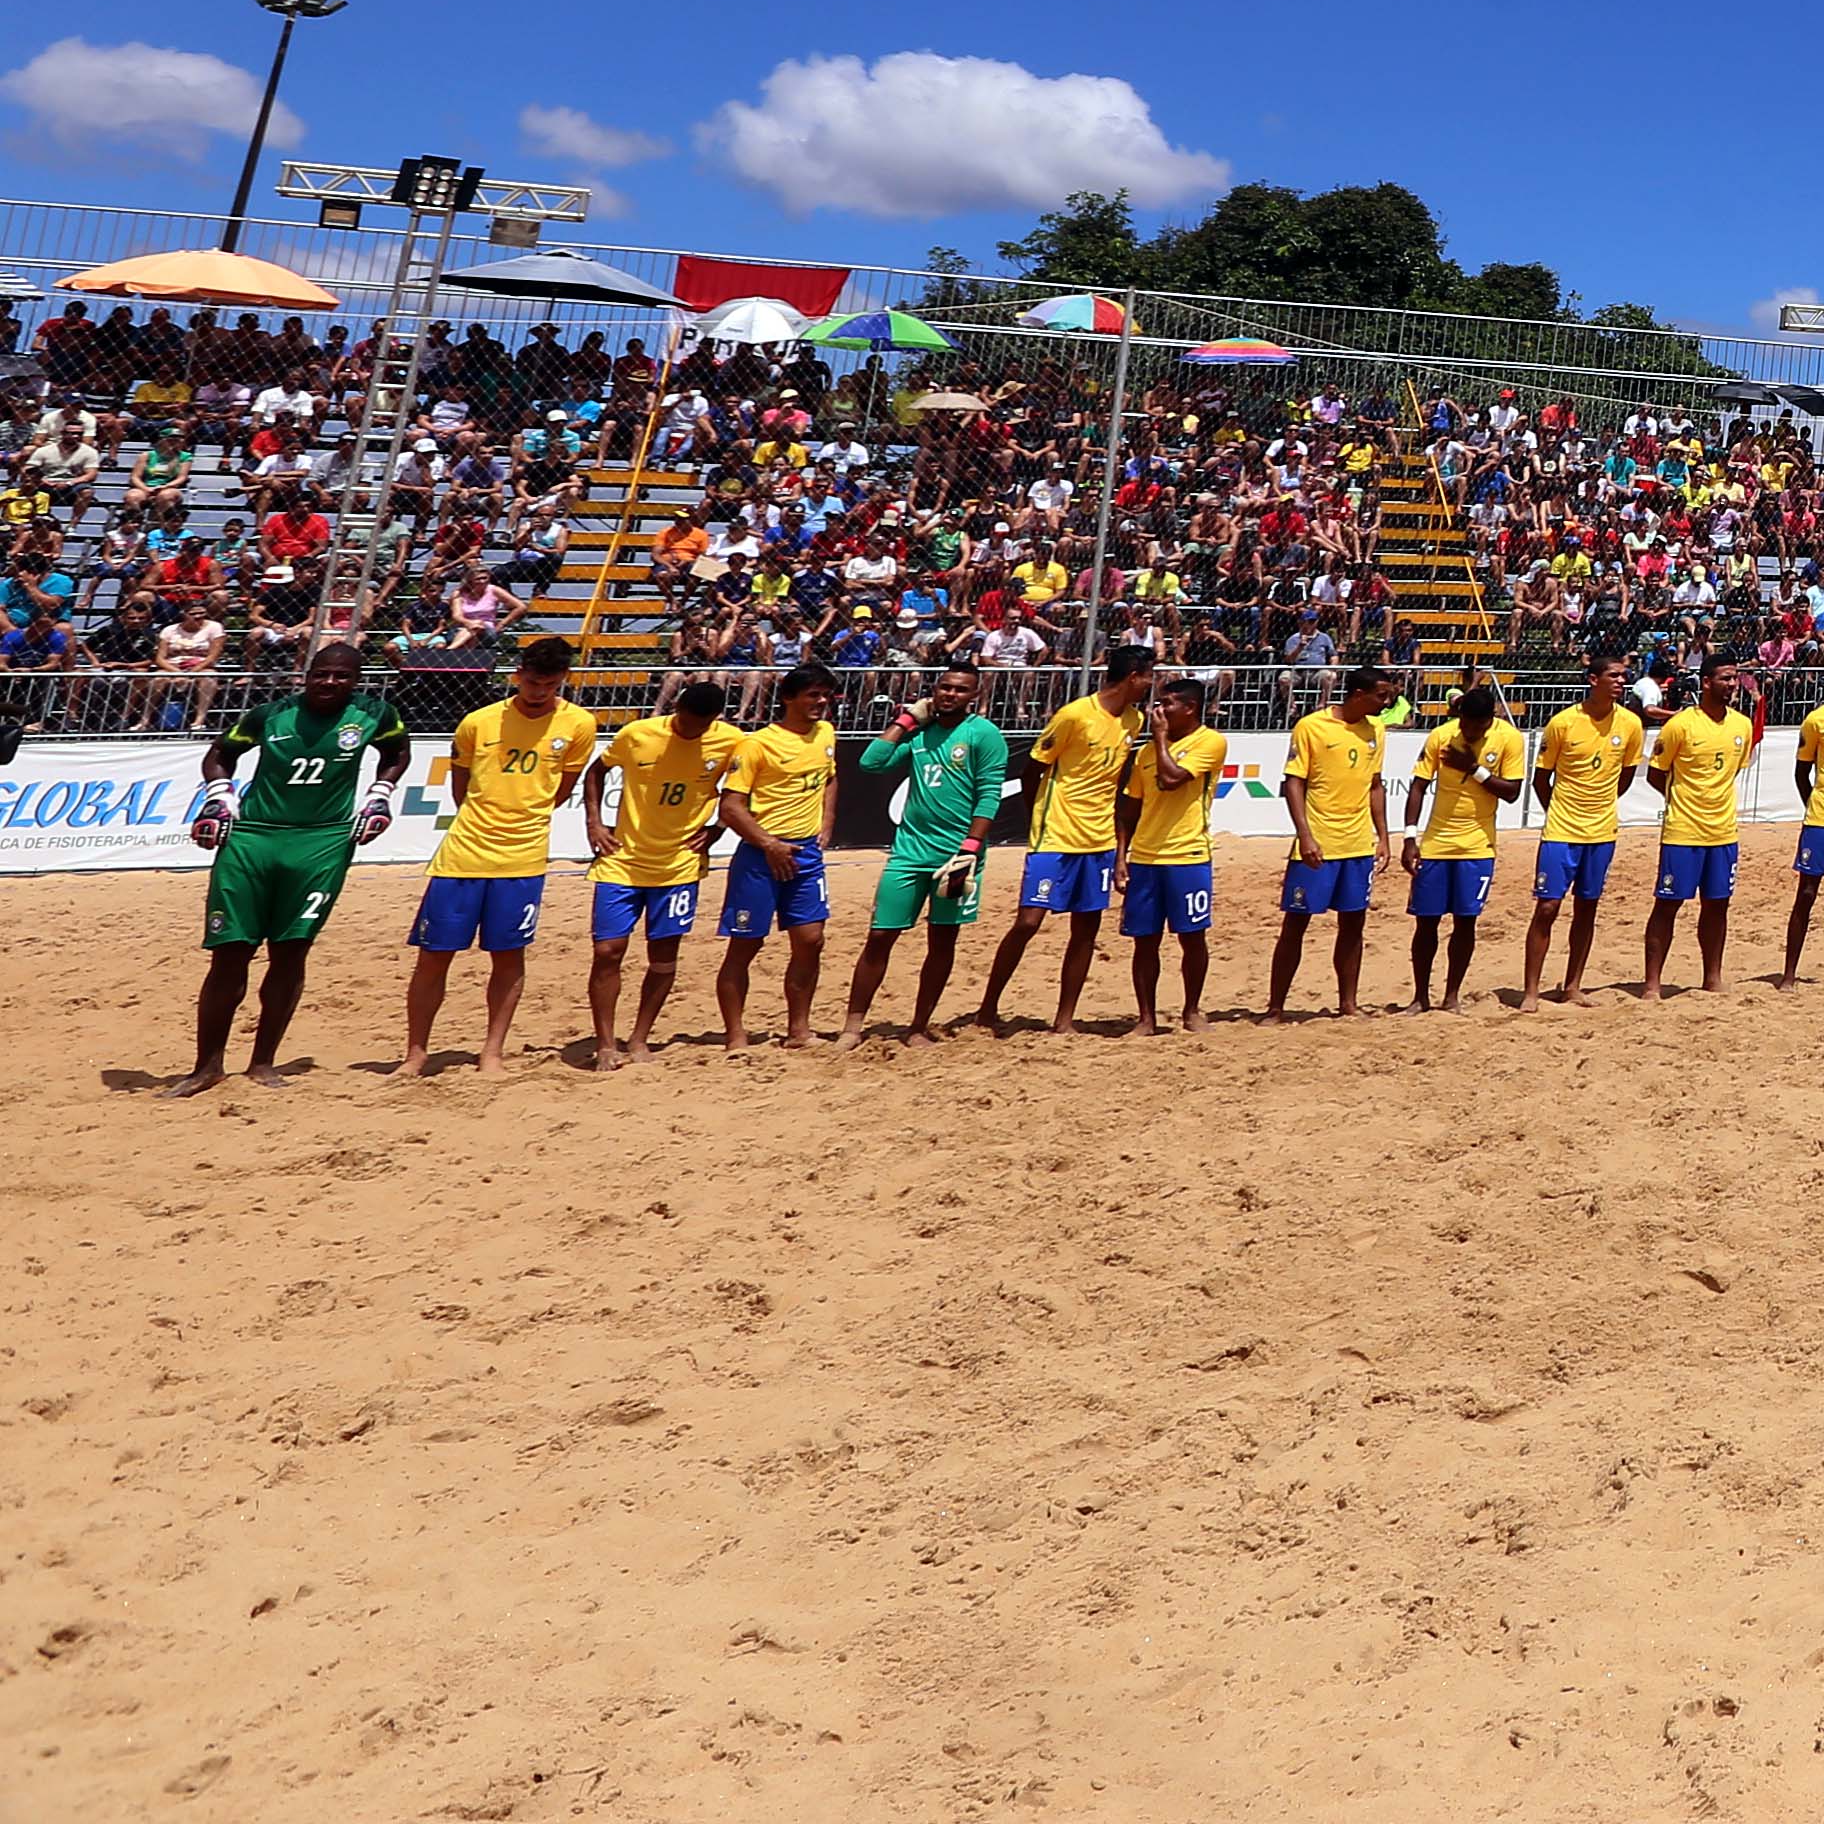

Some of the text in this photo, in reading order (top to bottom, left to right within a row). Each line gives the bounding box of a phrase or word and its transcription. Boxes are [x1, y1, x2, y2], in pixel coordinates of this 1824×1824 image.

[287, 757, 326, 785] 22
[502, 748, 538, 775] 20
[1348, 748, 1359, 769] 9
[1591, 751, 1602, 770] 6
[1714, 751, 1724, 770] 5
[922, 763, 943, 788] 12
[0, 778, 174, 828] GLOBAL
[658, 781, 686, 807] 18
[24, 836, 46, 850] DE
[1476, 876, 1490, 900] 7
[301, 891, 331, 919] 2
[667, 889, 691, 919] 18
[1185, 889, 1209, 916] 10
